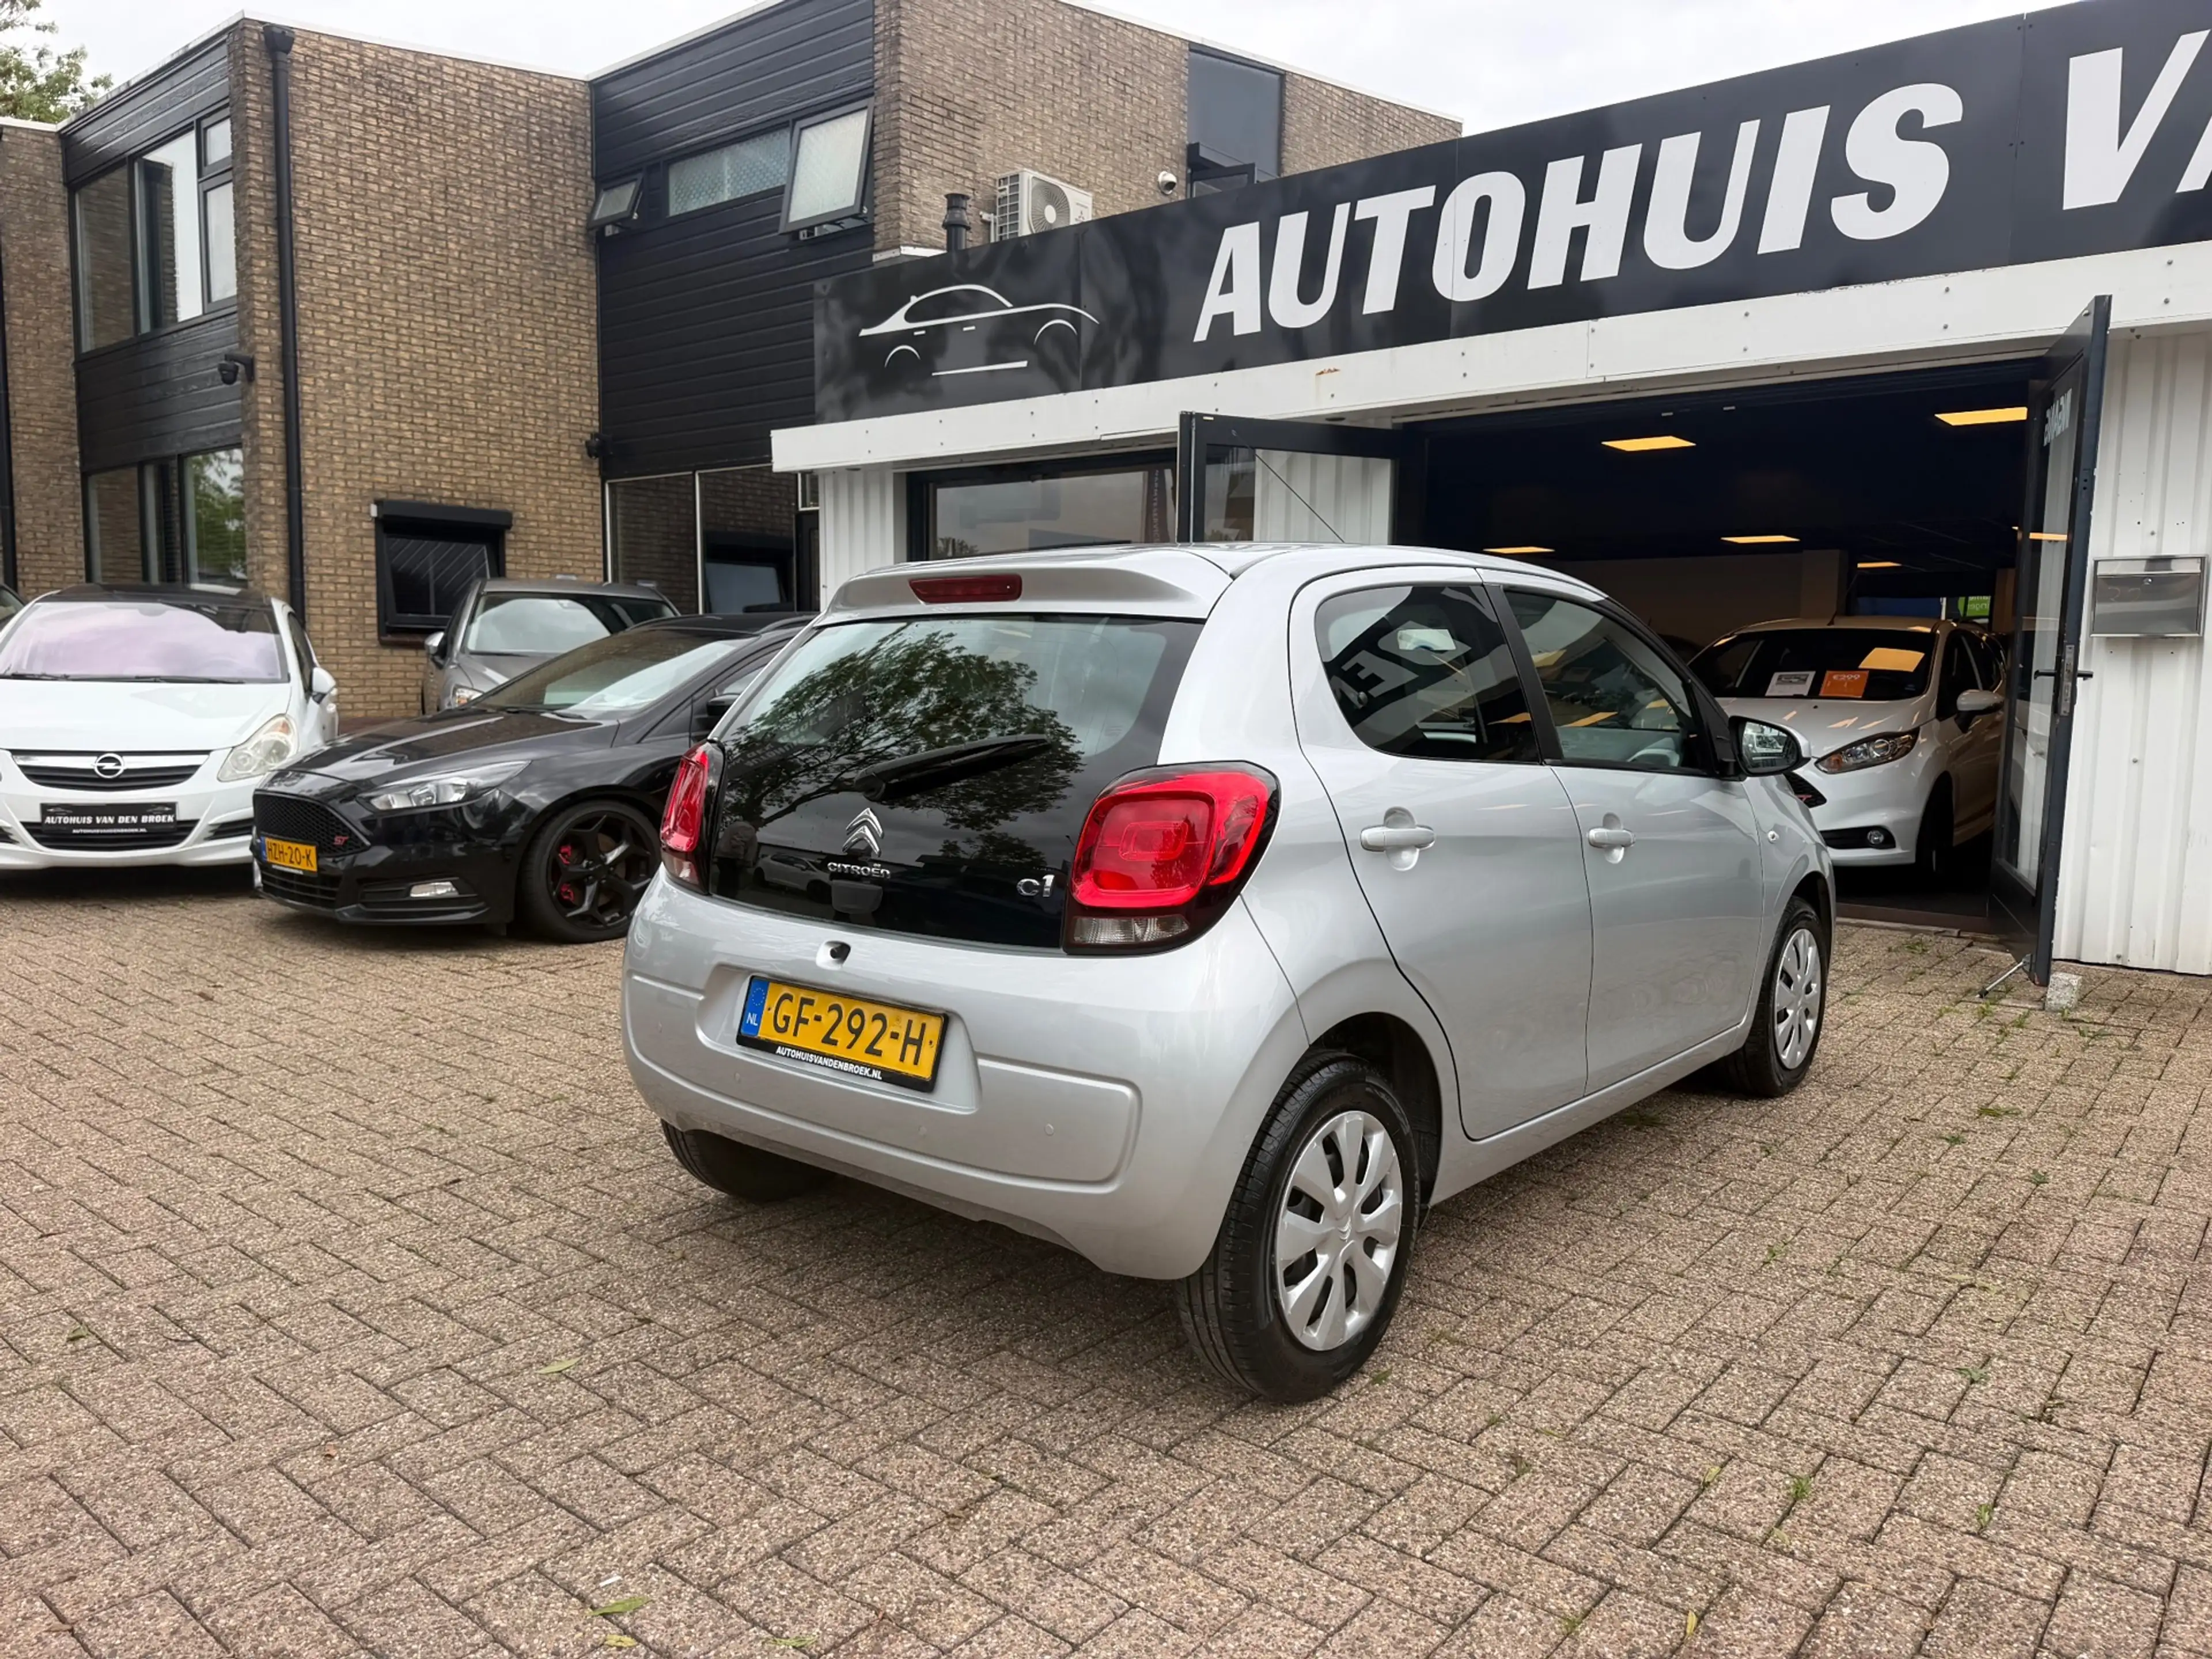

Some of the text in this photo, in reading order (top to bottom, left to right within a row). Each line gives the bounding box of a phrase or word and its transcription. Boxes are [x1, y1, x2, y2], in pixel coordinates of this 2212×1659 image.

[1194, 29, 2212, 342] AUTOHUIS V
[45, 814, 175, 824] AUTOHUIS VAN DEN BROEK
[334, 836, 349, 846] ST
[267, 840, 313, 868] HZH-20-K
[1016, 874, 1055, 897] C1
[746, 1013, 758, 1027] NL
[773, 993, 926, 1065] GF-292-H
[775, 1046, 882, 1080] AUTOHUISVANDENBROEK.NL
